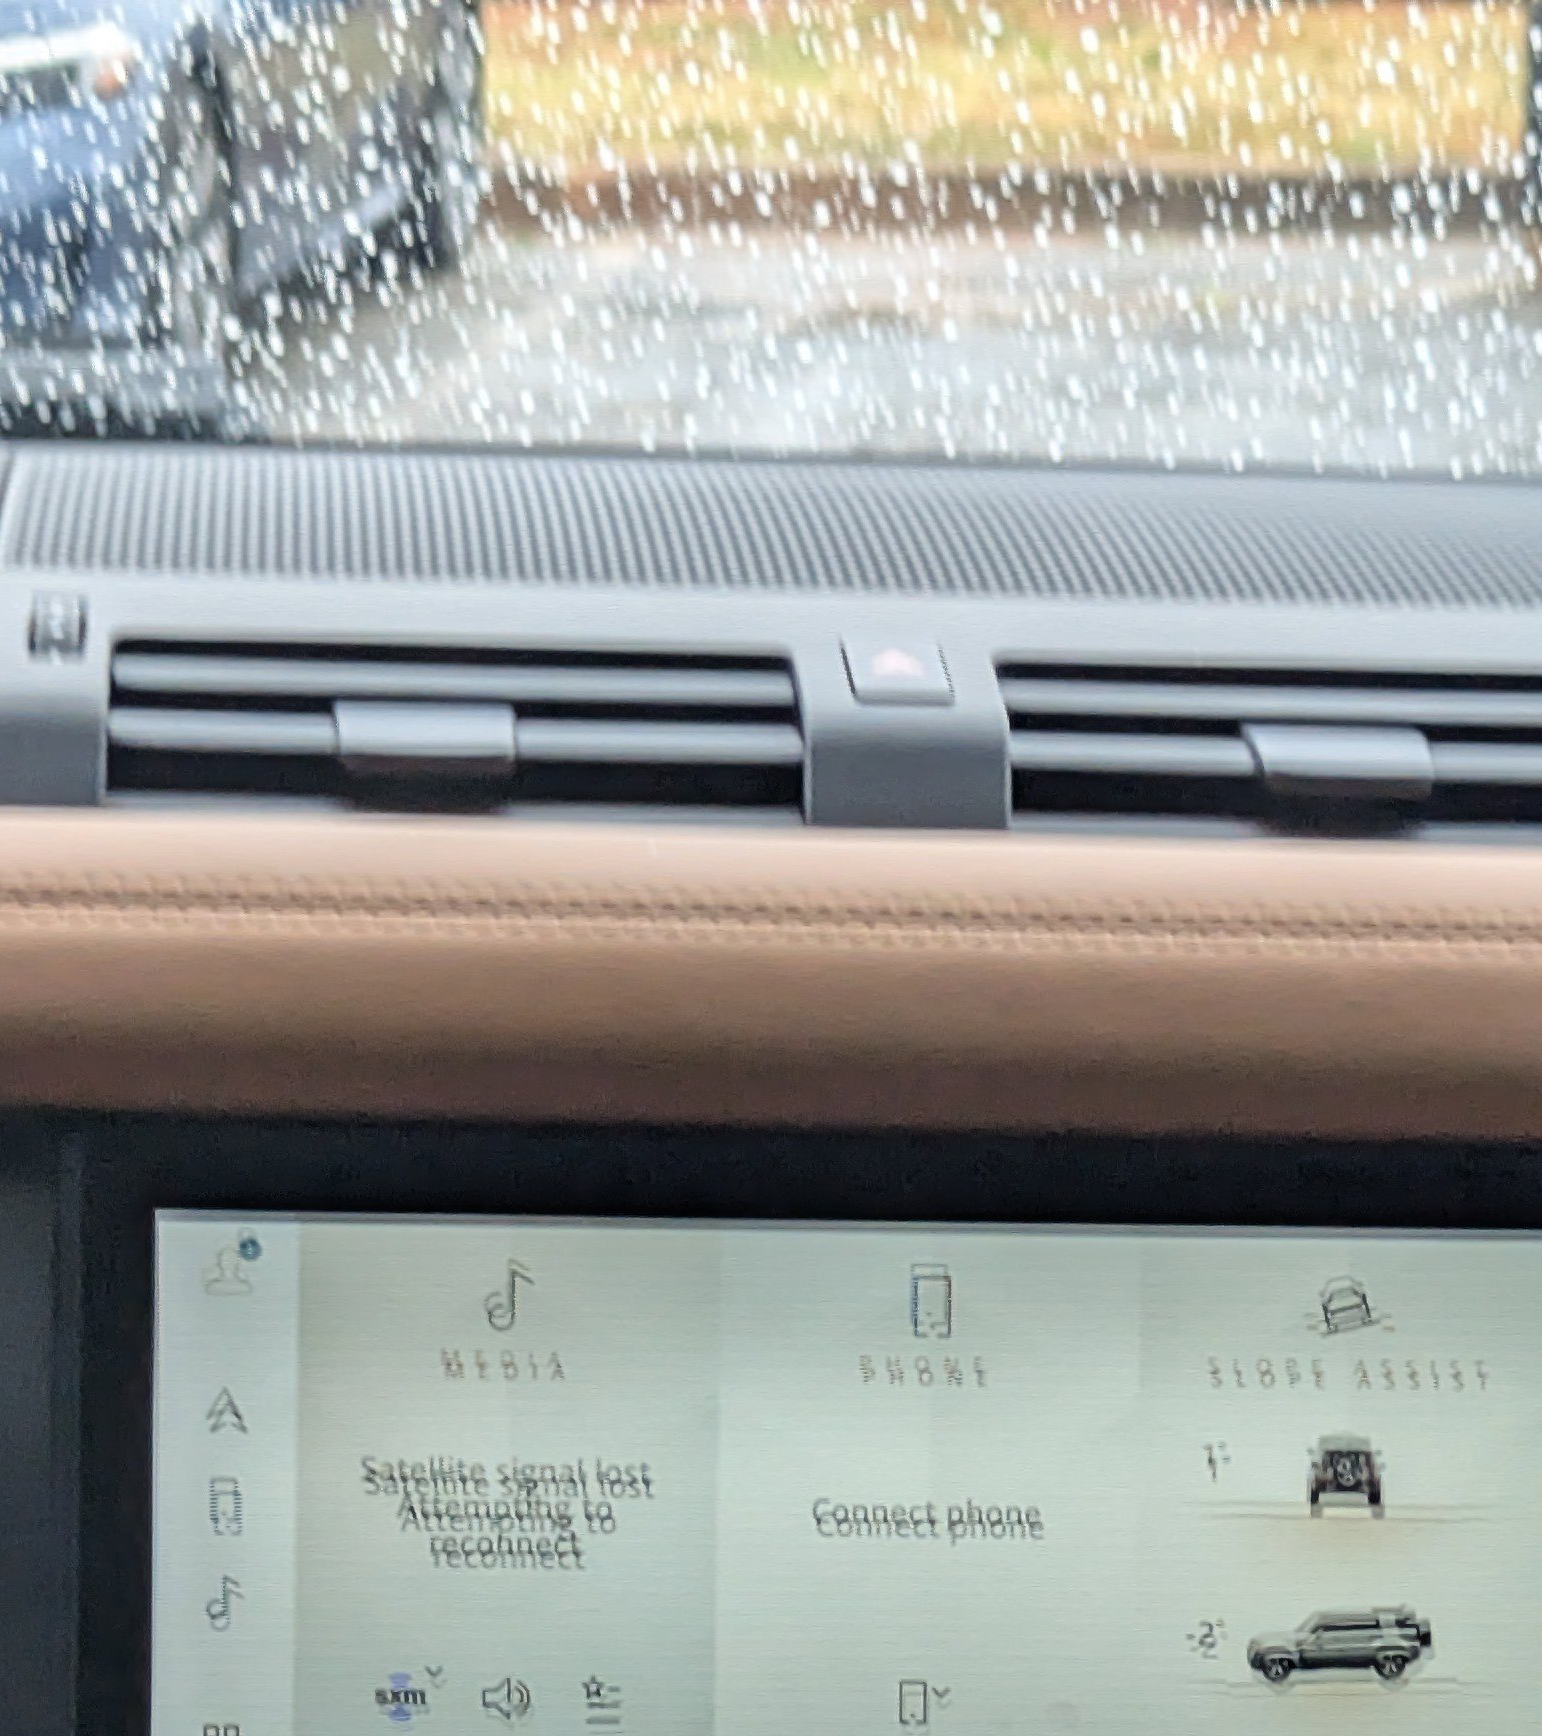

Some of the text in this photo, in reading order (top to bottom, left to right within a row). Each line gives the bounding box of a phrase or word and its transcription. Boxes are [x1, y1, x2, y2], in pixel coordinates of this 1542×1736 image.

[360, 1453, 490, 1497] Satellite
[812, 1498, 1046, 1547] Connect phone
